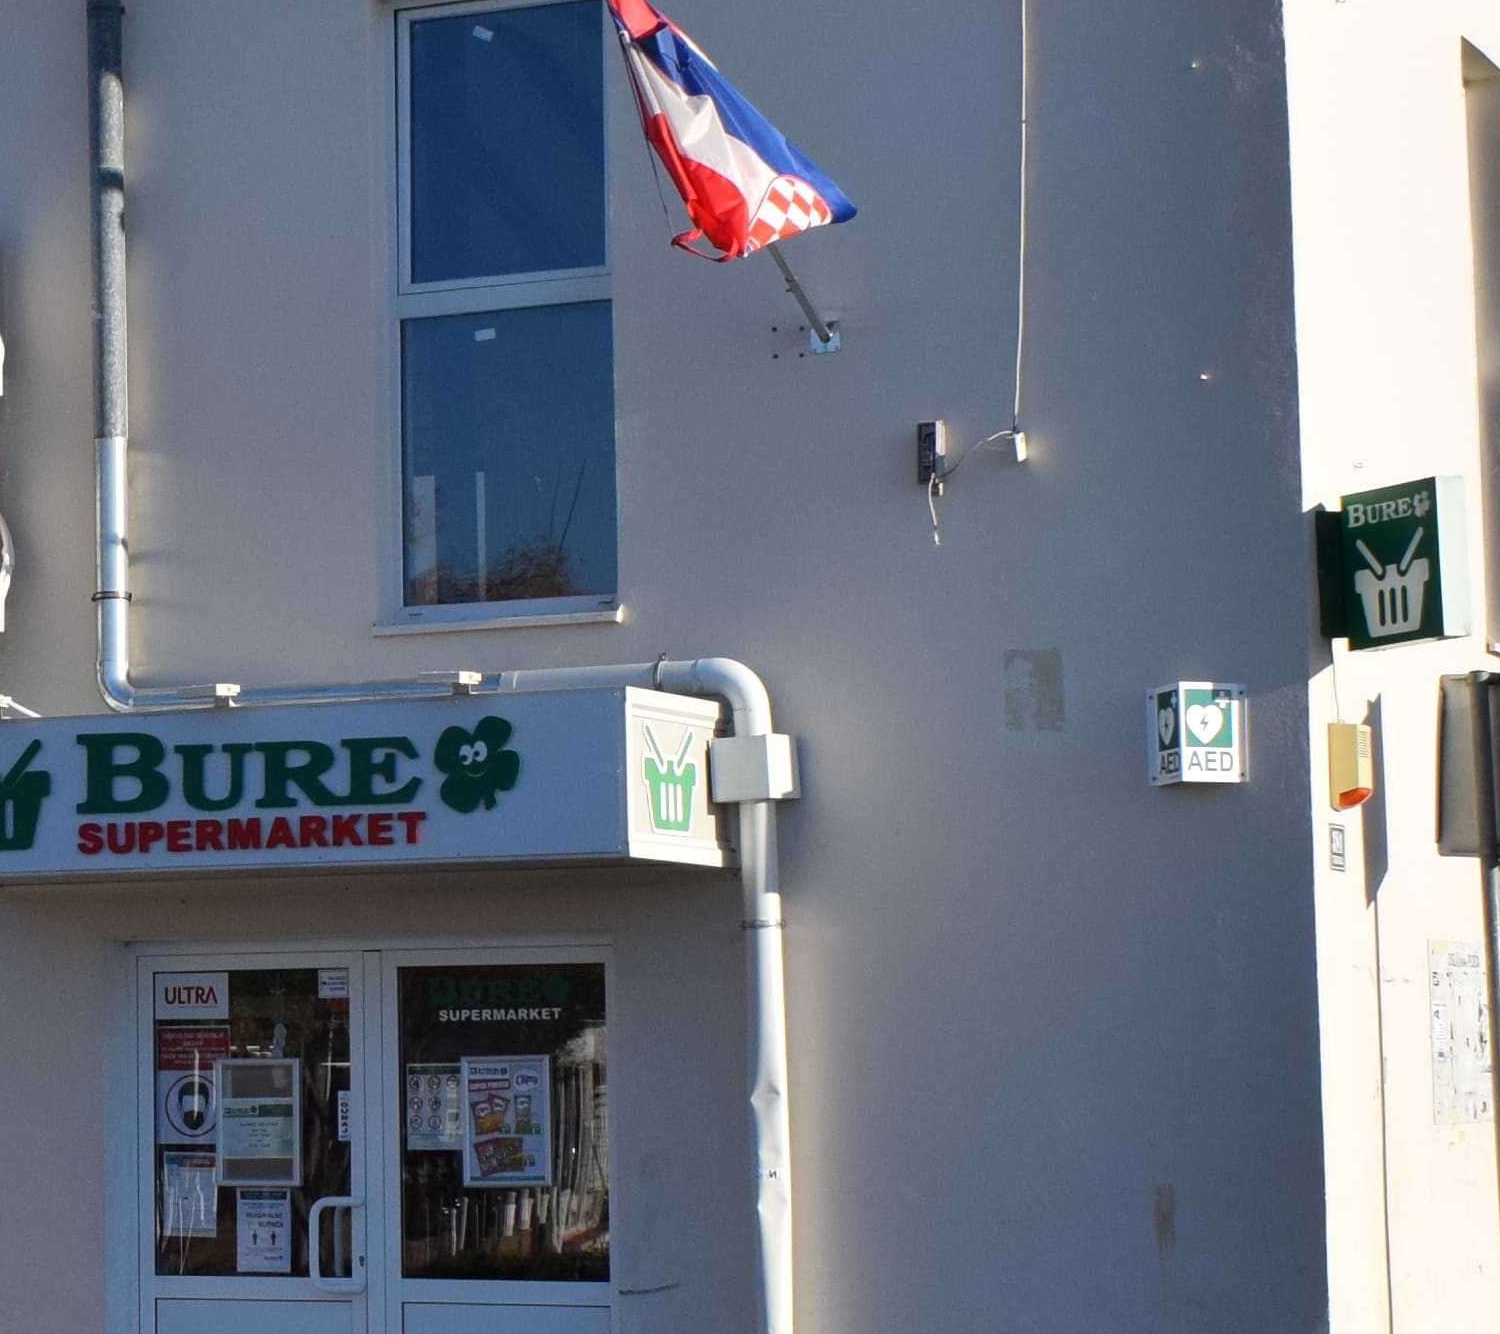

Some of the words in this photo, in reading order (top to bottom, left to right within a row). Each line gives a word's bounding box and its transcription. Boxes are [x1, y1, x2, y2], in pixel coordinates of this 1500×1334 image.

[1346, 497, 1413, 529] BURE
[76, 732, 423, 814] BURE
[1187, 750, 1234, 772] AED
[77, 811, 427, 856] SUPERMARKET
[164, 985, 219, 1005] ULTRA
[438, 1007, 562, 1023] SUPERMARKET
